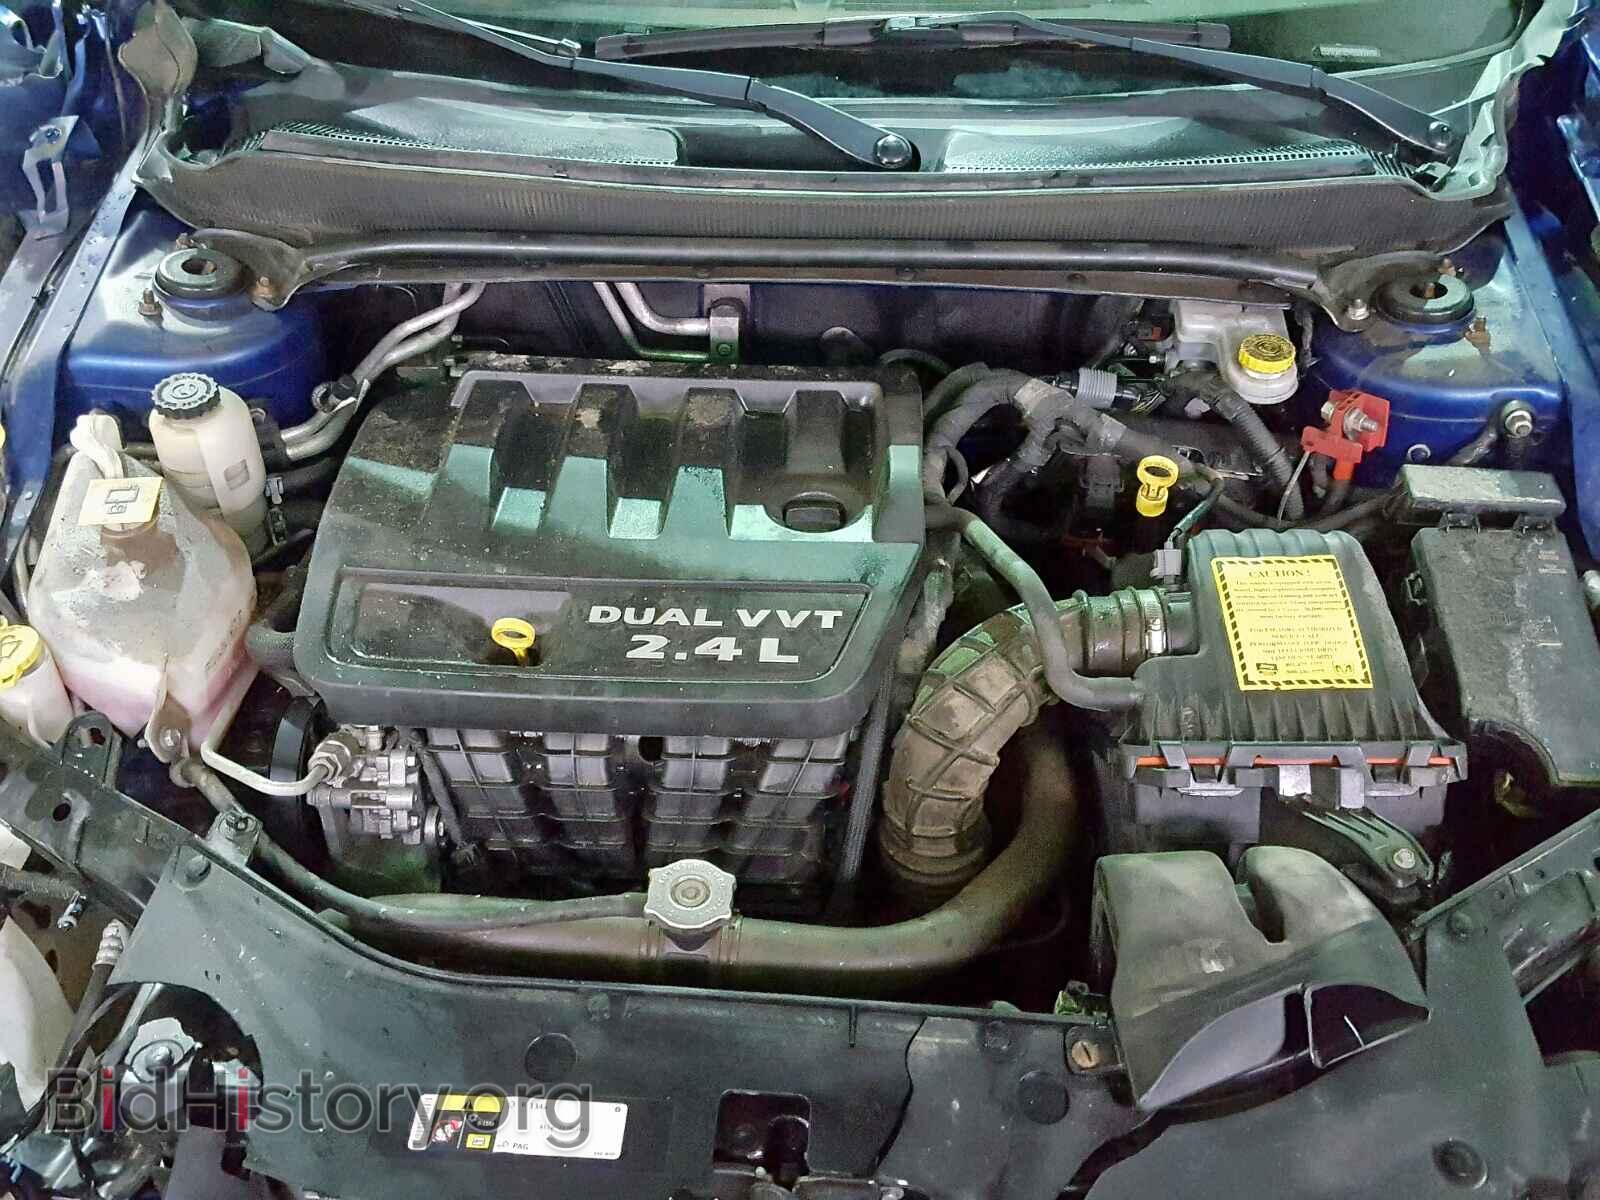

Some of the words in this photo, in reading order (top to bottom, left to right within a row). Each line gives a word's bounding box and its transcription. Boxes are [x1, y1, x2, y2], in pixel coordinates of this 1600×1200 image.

[588, 605, 723, 627] DUAL
[736, 609, 843, 629] VVT
[625, 634, 743, 662] 2.4
[758, 637, 799, 663] L
